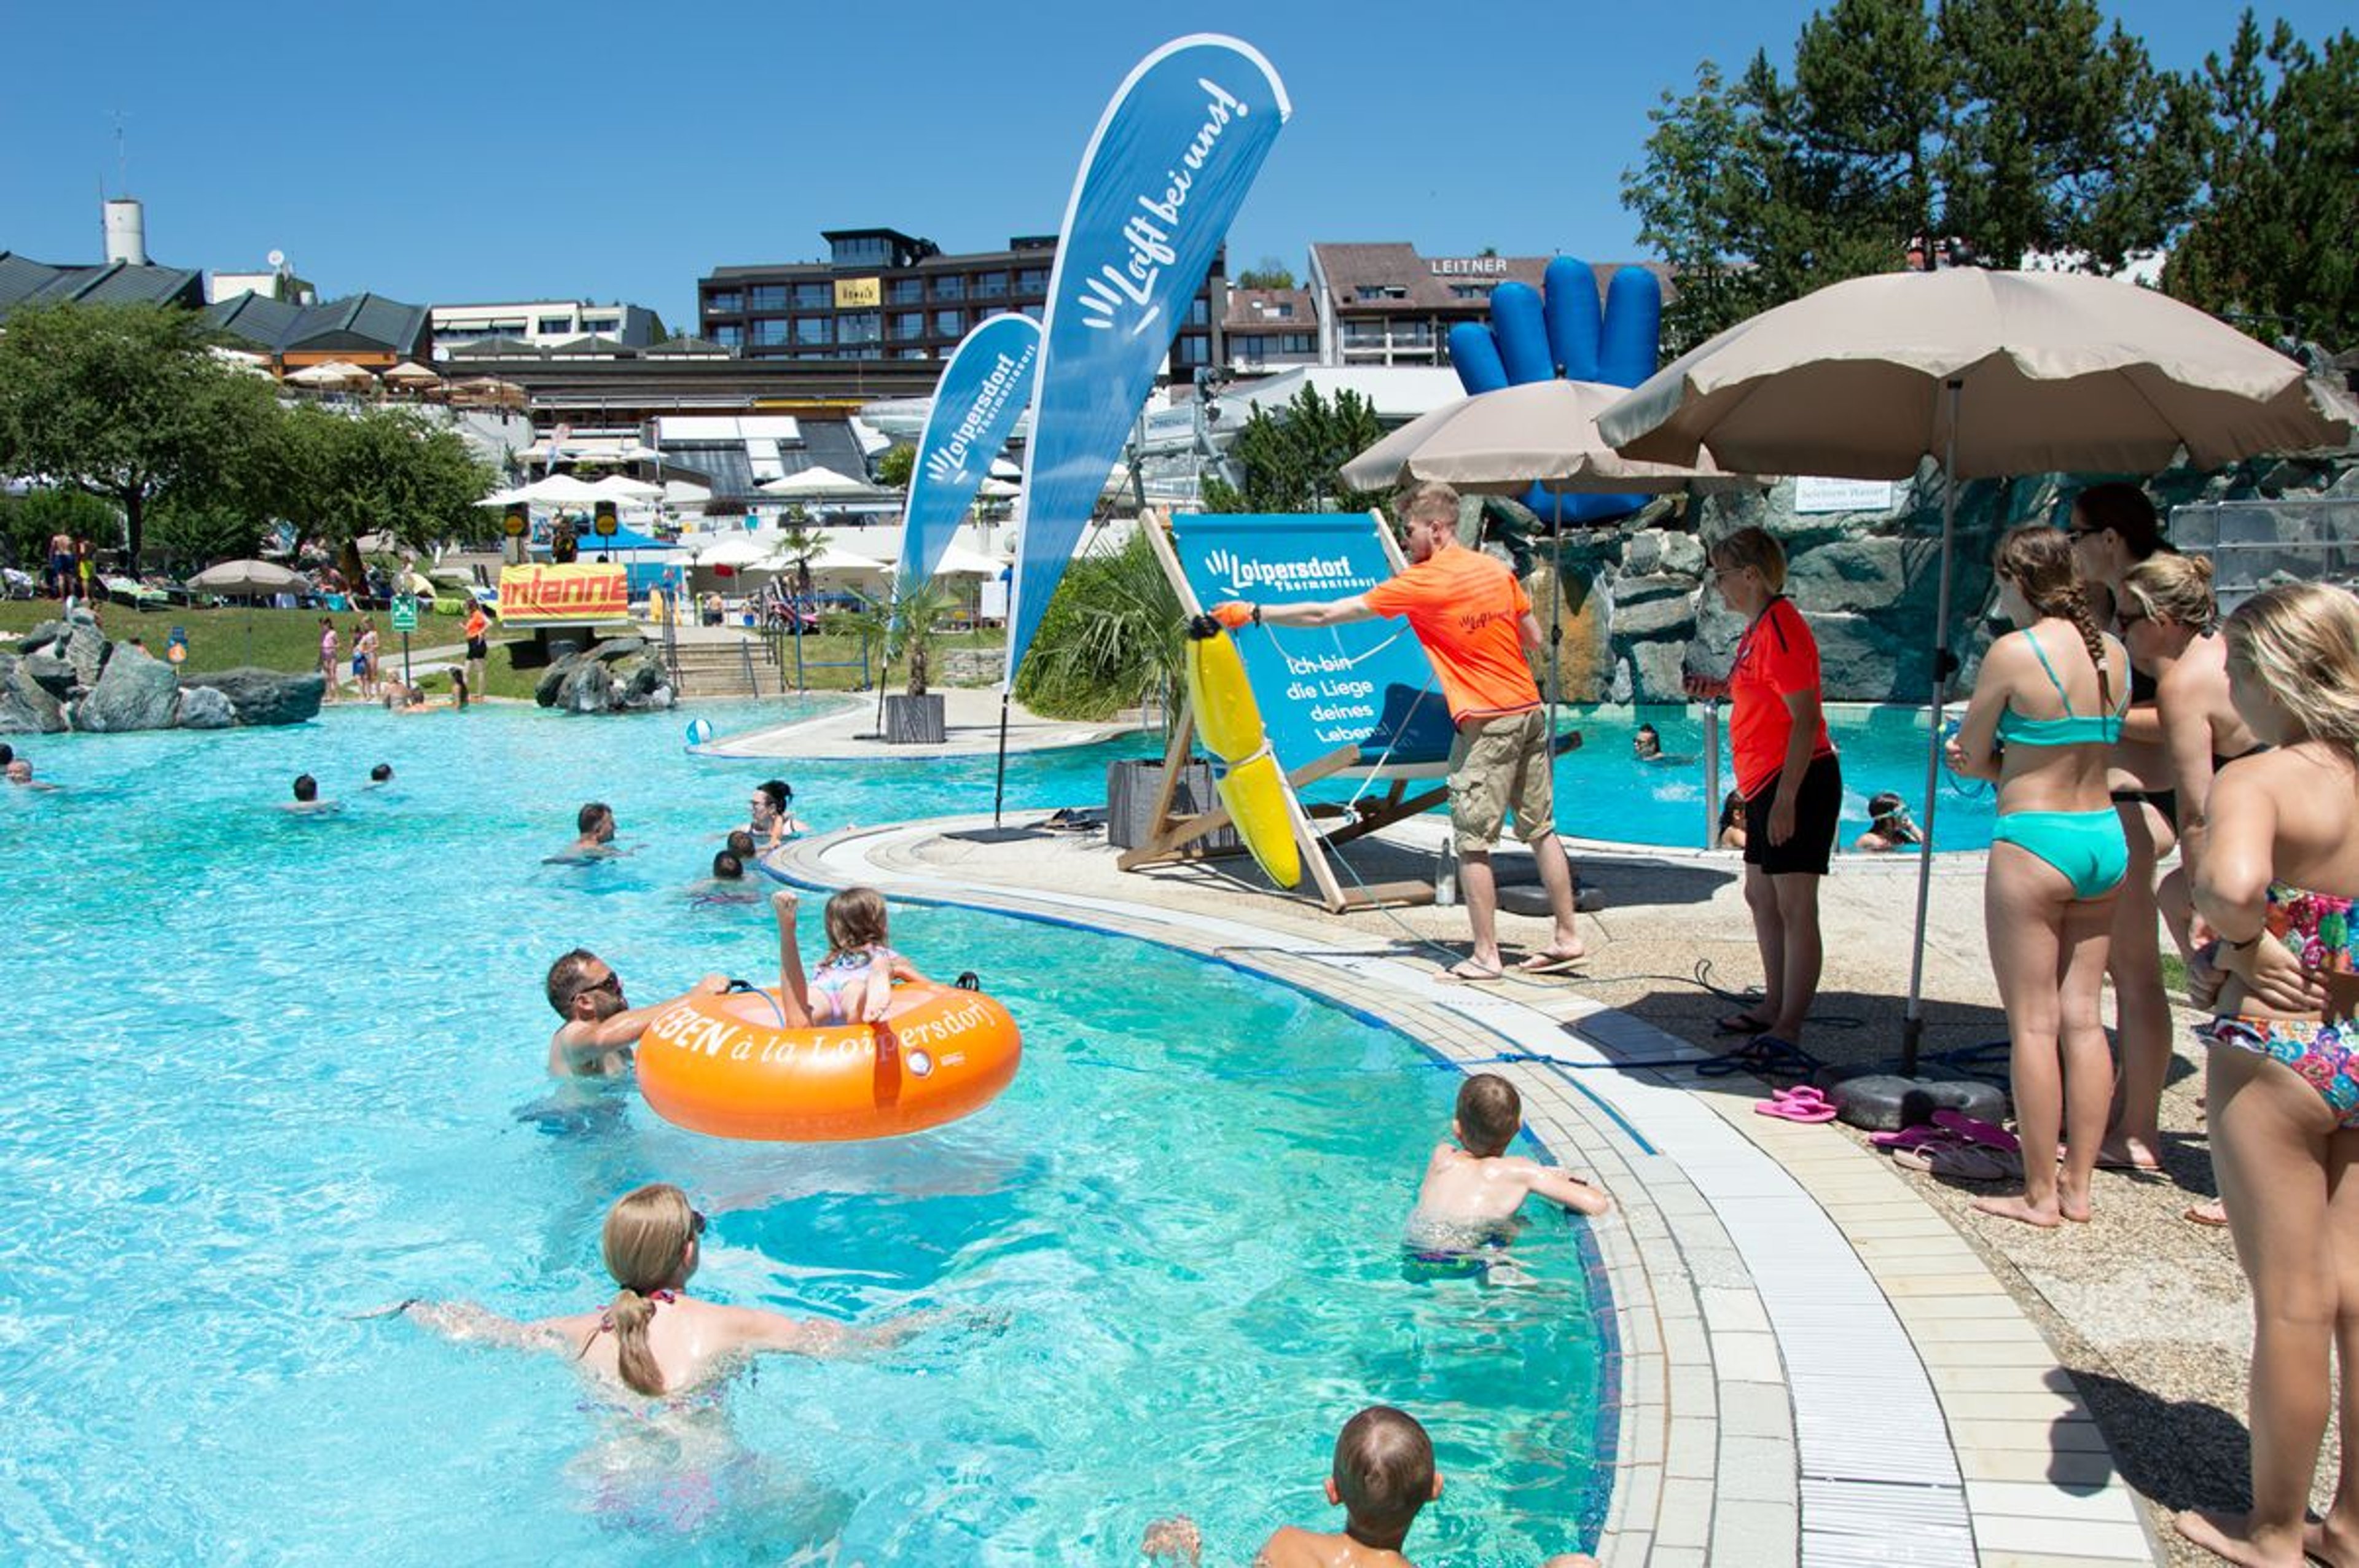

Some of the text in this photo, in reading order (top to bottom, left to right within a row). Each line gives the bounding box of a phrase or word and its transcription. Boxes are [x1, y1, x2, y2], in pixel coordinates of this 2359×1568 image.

[1102, 78, 1248, 306] Loift bei uns!
[1432, 259, 1508, 273] LEITNER
[939, 353, 1014, 470] Loipersdorf
[1231, 554, 1352, 588] Loipersdorf
[1286, 654, 1352, 674] Ich bin
[1286, 679, 1374, 700] die Liege
[1310, 703, 1374, 722] deines
[731, 1034, 753, 1061] à
[761, 1036, 796, 1063] la
